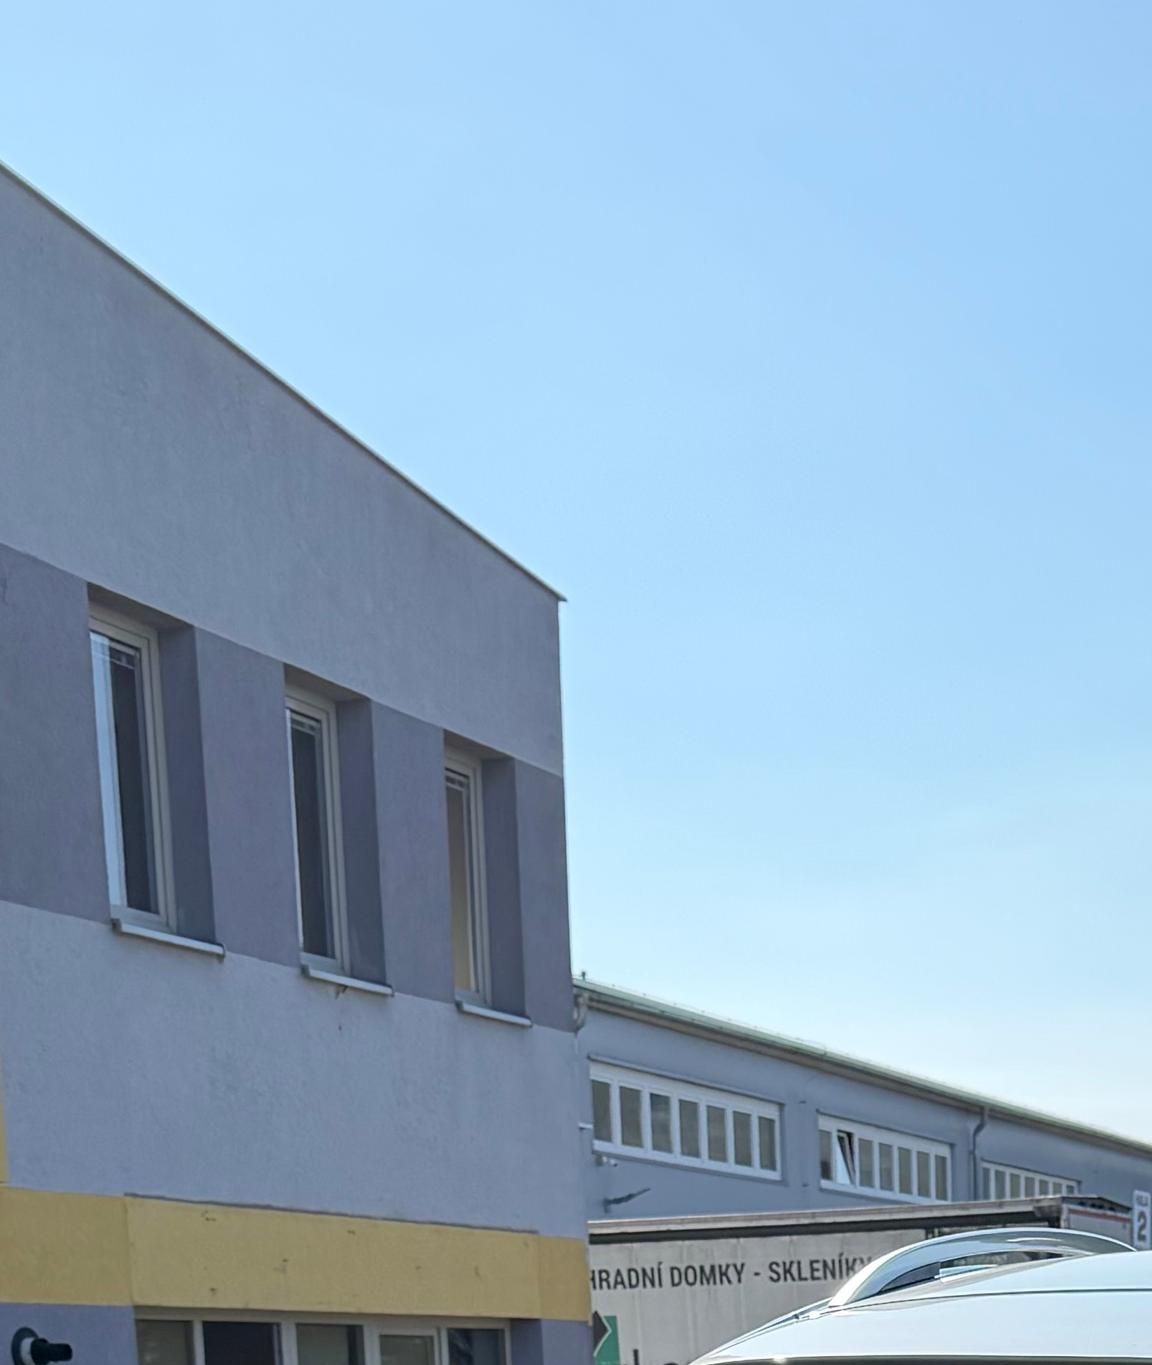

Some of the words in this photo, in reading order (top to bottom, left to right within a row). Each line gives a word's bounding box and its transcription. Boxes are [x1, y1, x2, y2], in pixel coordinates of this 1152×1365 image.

[1137, 1210, 1147, 1242] 2
[669, 1262, 745, 1288] DOMKY
[768, 1252, 872, 1283] SKLENÍK
